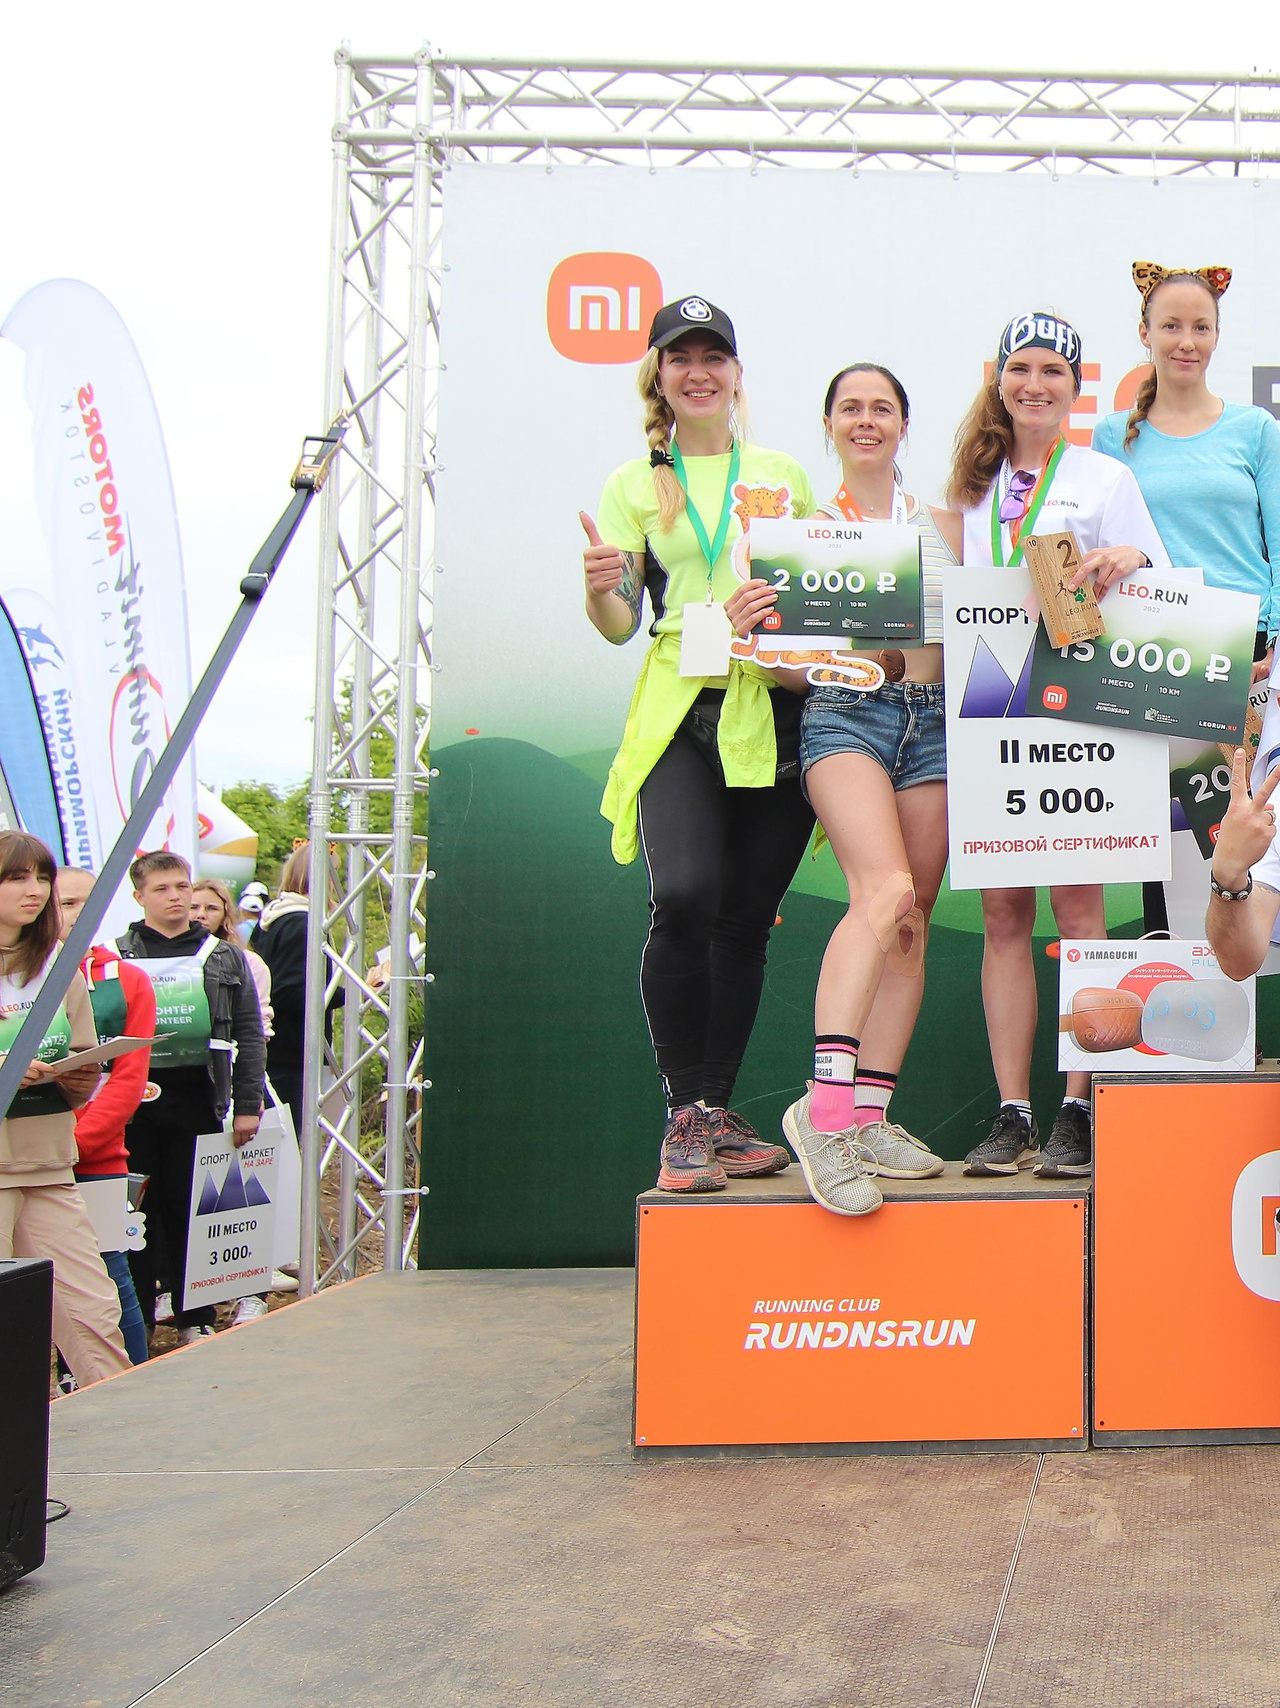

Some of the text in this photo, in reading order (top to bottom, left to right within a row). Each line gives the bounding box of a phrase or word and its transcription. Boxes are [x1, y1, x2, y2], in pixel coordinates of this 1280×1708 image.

[1043, 500, 1079, 509] LEO.RUN
[807, 529, 862, 541] LEO.RUN
[1057, 540, 1078, 568] 2
[772, 568, 791, 592] 2
[800, 570, 867, 594] 000
[1118, 582, 1188, 606] LEO.RUN
[1142, 605, 1160, 614] 2022
[1109, 638, 1192, 677] 000
[1108, 678, 1135, 689] МЕСТО
[1159, 686, 1168, 694] 10
[1198, 720, 1237, 731] LEORUN.RU
[1028, 743, 1115, 763] МЕСТО
[1005, 789, 1026, 815] 5
[963, 834, 1160, 854] ПРИЗОВОЙ СЕРТИФИКАТ
[1084, 950, 1138, 960] YAMAGUCHI
[1191, 959, 1215, 967] PIL
[200, 1147, 275, 1166] СПОРТ МАРКЕТ
[243, 1158, 274, 1168] НА ЗАРЕ
[223, 1220, 257, 1236] МЕСТО
[209, 1251, 218, 1265] 3
[190, 1266, 268, 1290] ПРИЗОВОЙ СЕРТИФИКАТ
[753, 1298, 881, 1313] RUNNING CLUB
[744, 1318, 976, 1350] RUNDNSRUN
